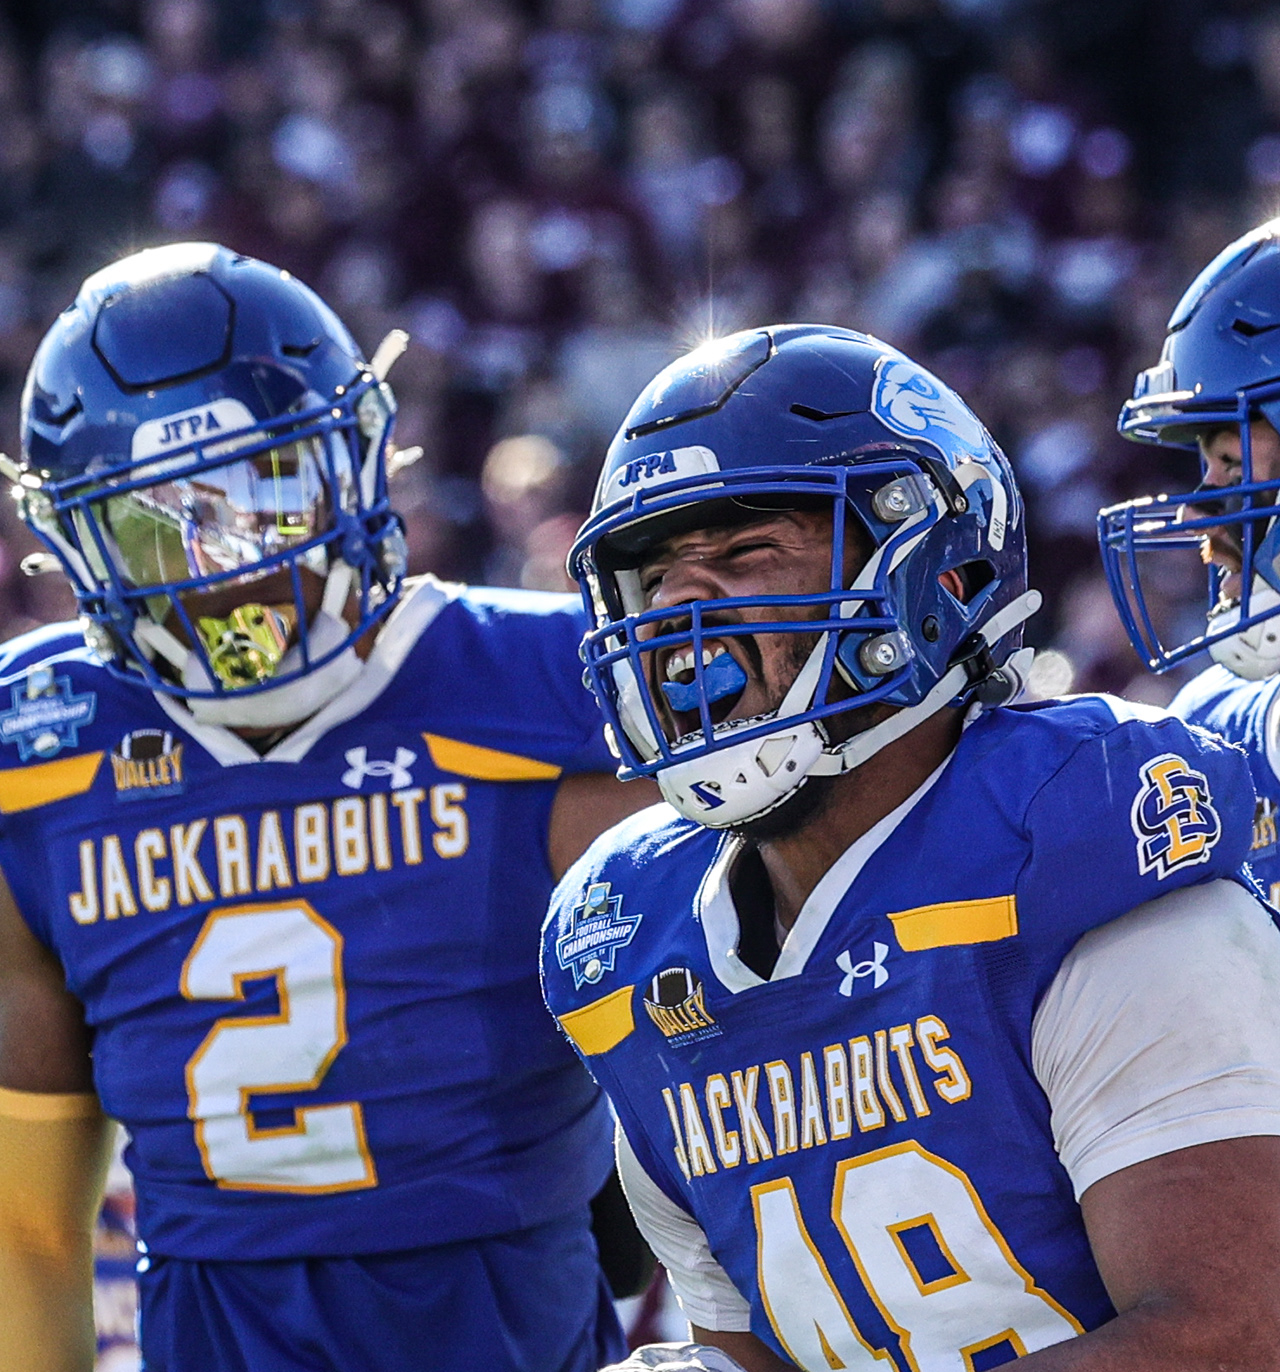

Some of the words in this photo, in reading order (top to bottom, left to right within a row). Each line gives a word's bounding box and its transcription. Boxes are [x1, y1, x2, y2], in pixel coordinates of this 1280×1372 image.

[160, 411, 221, 444] JFPA
[619, 450, 677, 487] JFPA
[69, 783, 468, 924] JACKRABBITS
[563, 924, 632, 959] CHAMPIONSHIP
[576, 918, 611, 939] FOOTBALL
[643, 982, 715, 1037] VALLEY
[179, 899, 378, 1194] 2
[662, 1015, 972, 1179] JACKRABBITS
